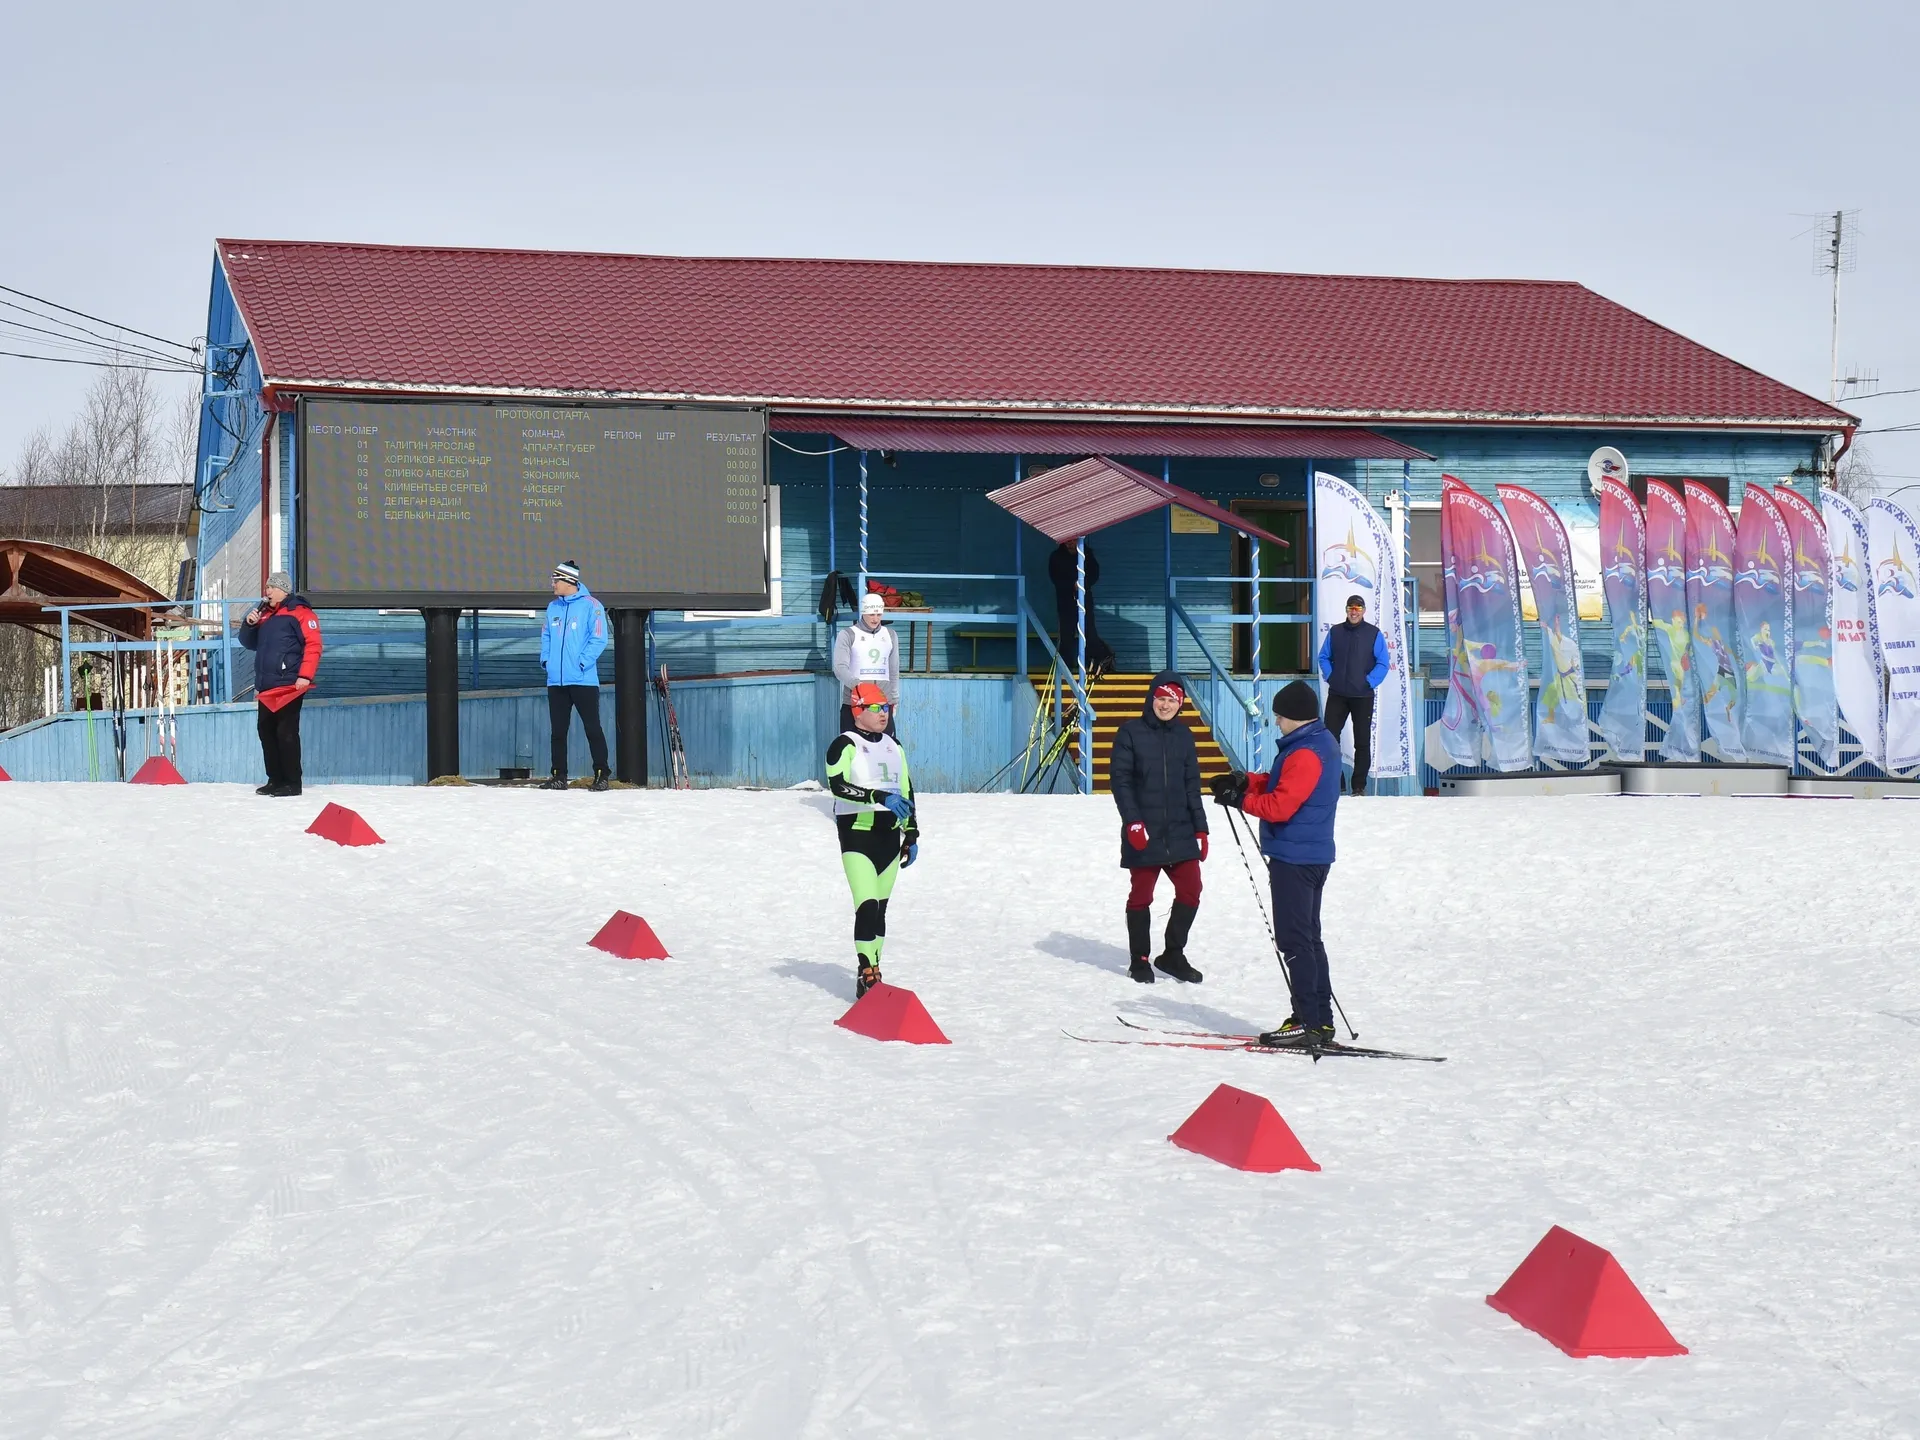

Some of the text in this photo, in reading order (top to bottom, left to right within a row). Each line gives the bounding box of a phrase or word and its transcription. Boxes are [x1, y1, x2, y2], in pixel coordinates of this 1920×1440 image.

[495, 409, 590, 421] ПРОТОКОЛ СТАРТА
[308, 425, 757, 442] МЕСТО НОМЕР УЧАСТНИК КОМАНДА РЕГИОН ШТР РЕЗУЛЬТАТ
[357, 440, 368, 449] 01
[384, 441, 428, 450] ТАЛИГИН
[430, 441, 475, 451] ЯРОСЛАВ
[522, 442, 563, 453] АППАРАТ
[565, 443, 596, 453] ГУБЕР
[357, 454, 368, 463] 02
[384, 455, 435, 464] ХОРЛИКОВ
[436, 455, 492, 465] АЛЕКСАНДР
[522, 456, 570, 466] ФИНАНСЫ
[357, 468, 368, 477] 03
[384, 469, 424, 478] СЛИВКО
[426, 468, 469, 478] АЛЕКСЕЙ
[522, 470, 580, 480] ЭКОНОМИКА
[357, 482, 368, 491] 04
[384, 483, 447, 492] КЛИМЕНТЬЕВ
[450, 482, 488, 493] СЕРГЕЙ
[522, 484, 566, 494] АЙСБЕРГ
[357, 496, 368, 505] 05
[429, 497, 462, 507] ВАДИМ
[522, 498, 563, 508] АРКТИКА
[357, 510, 369, 519] 06
[384, 511, 434, 521] ЕДЕЛЬКИН
[436, 511, 471, 521] ДЕНИС
[868, 648, 881, 664] 9
[877, 762, 893, 783] 1
